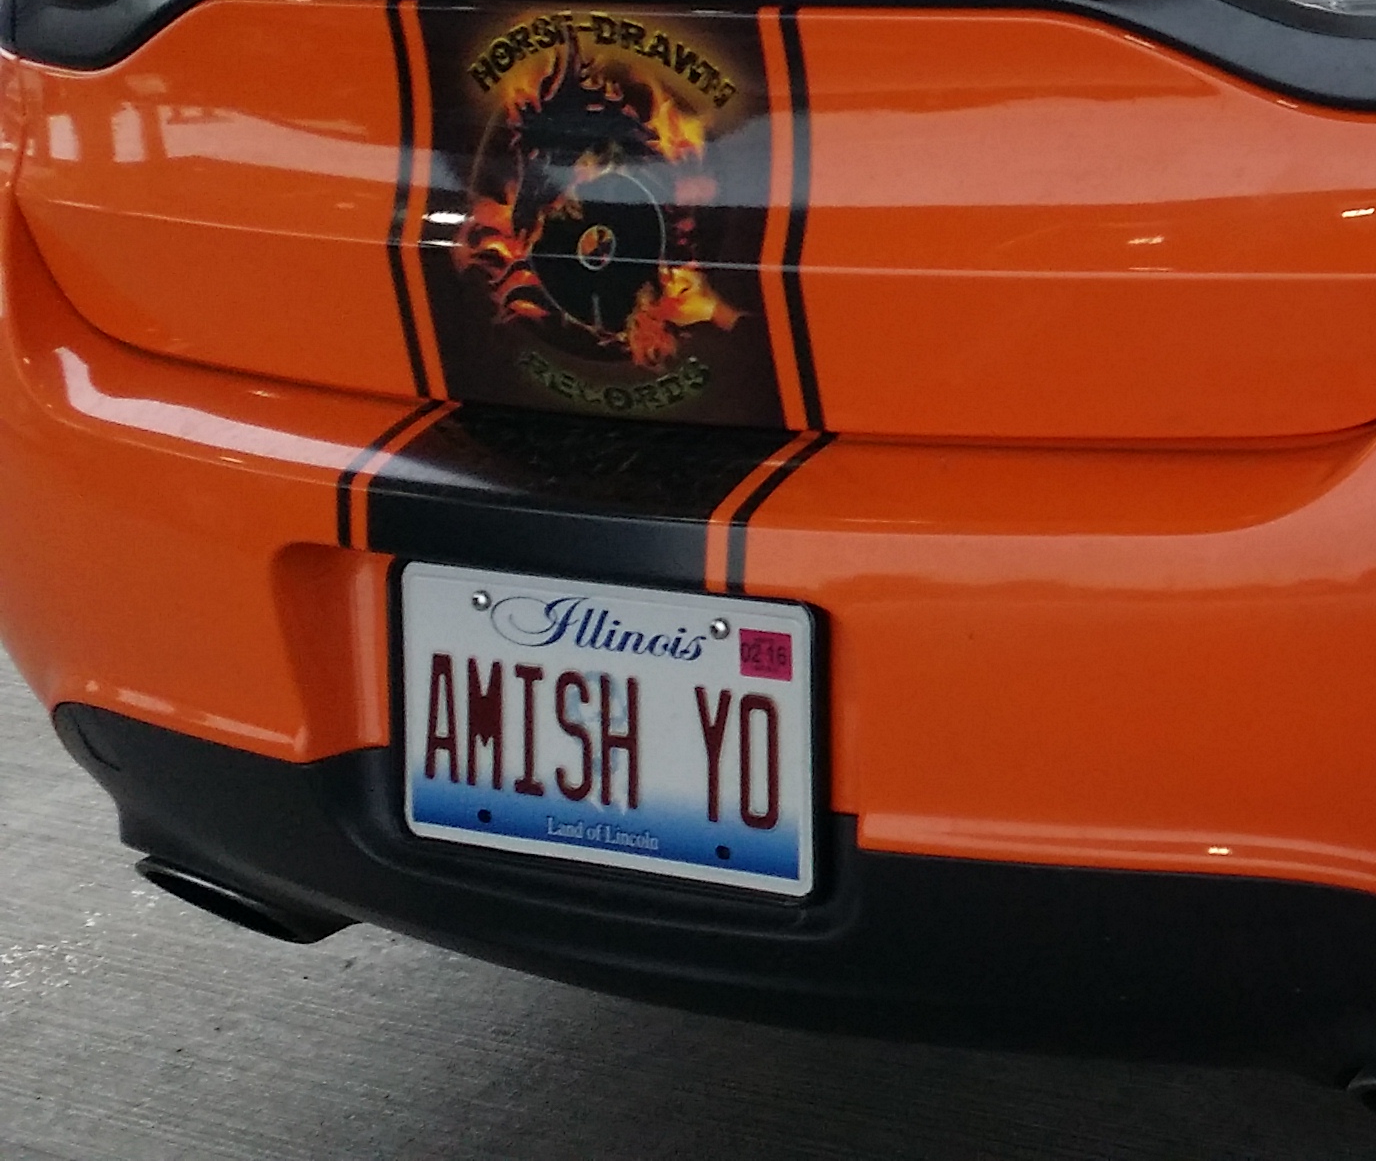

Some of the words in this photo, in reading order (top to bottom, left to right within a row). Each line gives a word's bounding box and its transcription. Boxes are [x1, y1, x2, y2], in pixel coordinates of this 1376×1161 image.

[468, 10, 737, 108] HORSE-DRAWN
[490, 596, 706, 662] Illinois
[424, 653, 639, 810] AMISH
[695, 686, 780, 829] YO
[547, 816, 584, 839] Land
[586, 823, 603, 841] of
[604, 824, 660, 851] Lincoln
